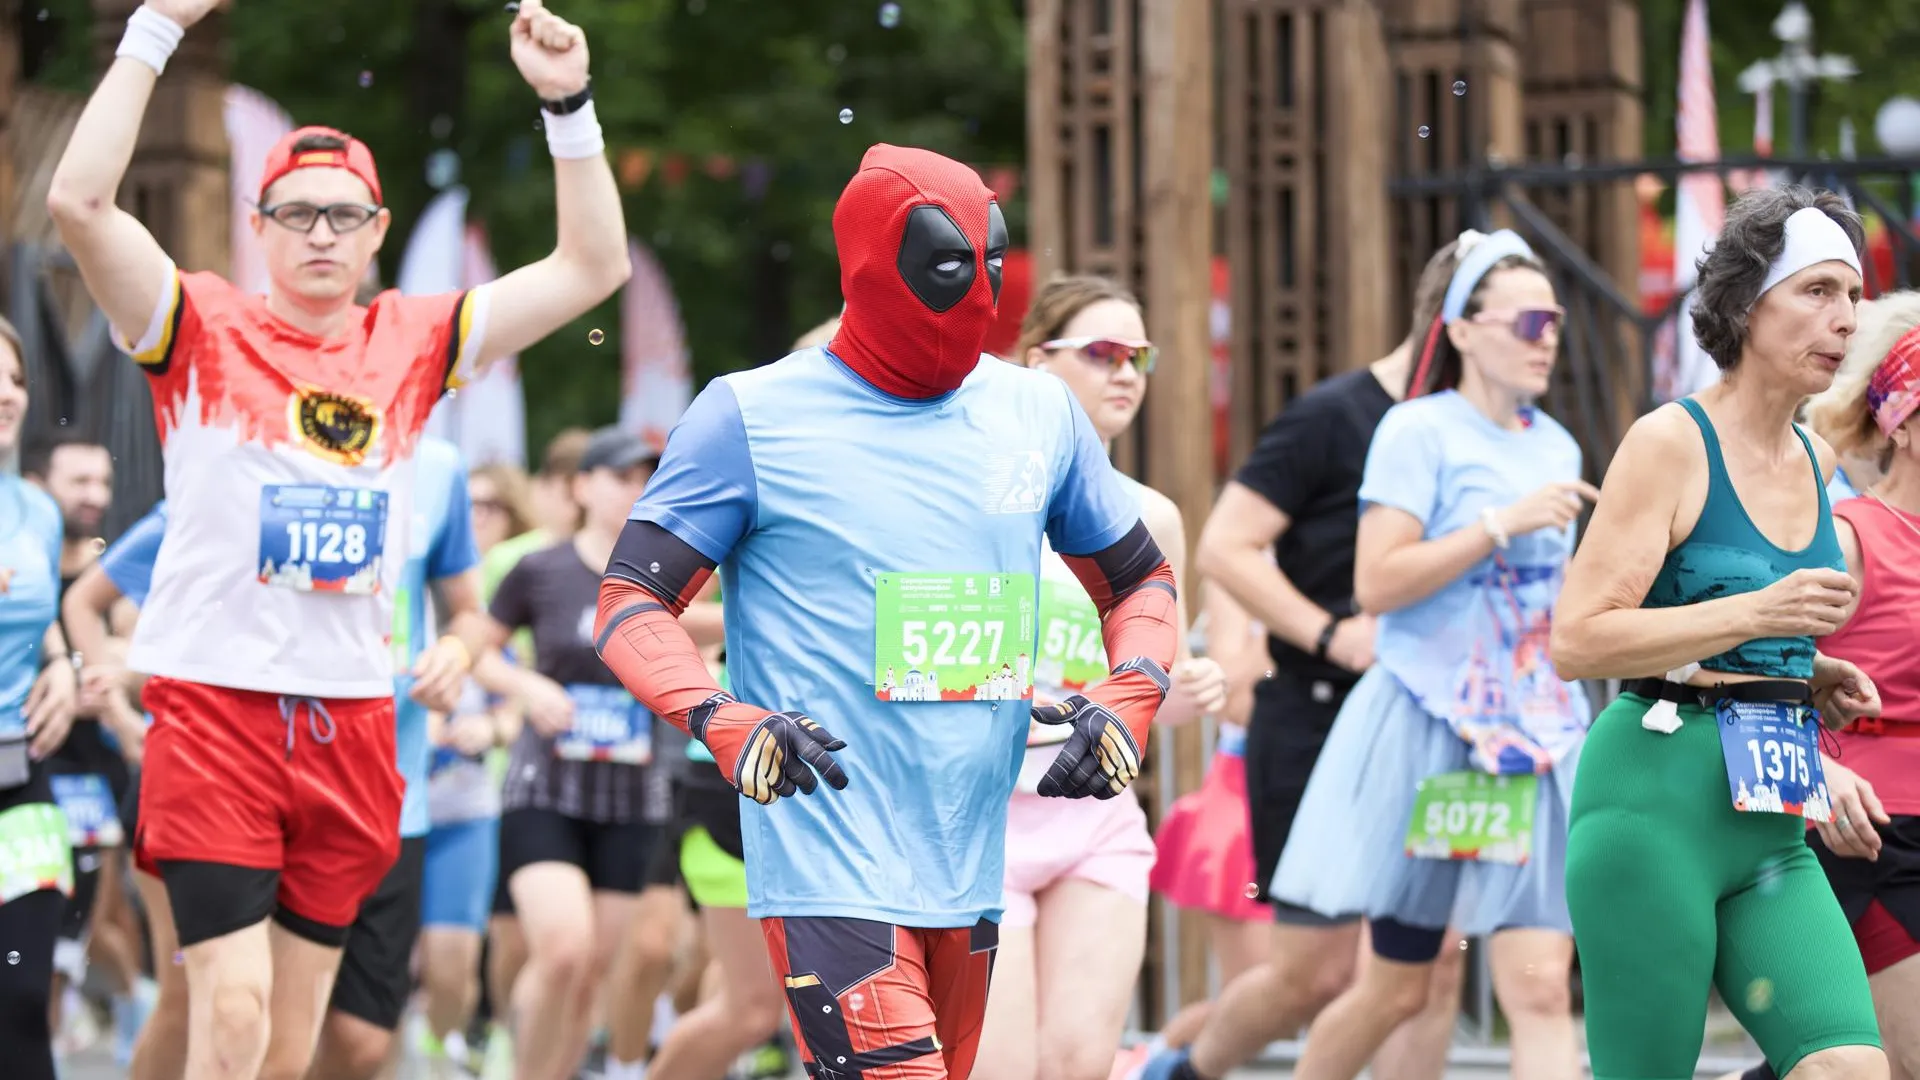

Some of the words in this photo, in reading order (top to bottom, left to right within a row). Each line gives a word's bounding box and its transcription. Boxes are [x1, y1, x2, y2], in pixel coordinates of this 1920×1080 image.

[286, 521, 367, 564] 1128
[902, 620, 1004, 666] 5227
[1747, 738, 1810, 788] 1375
[1424, 800, 1511, 838] 5072
